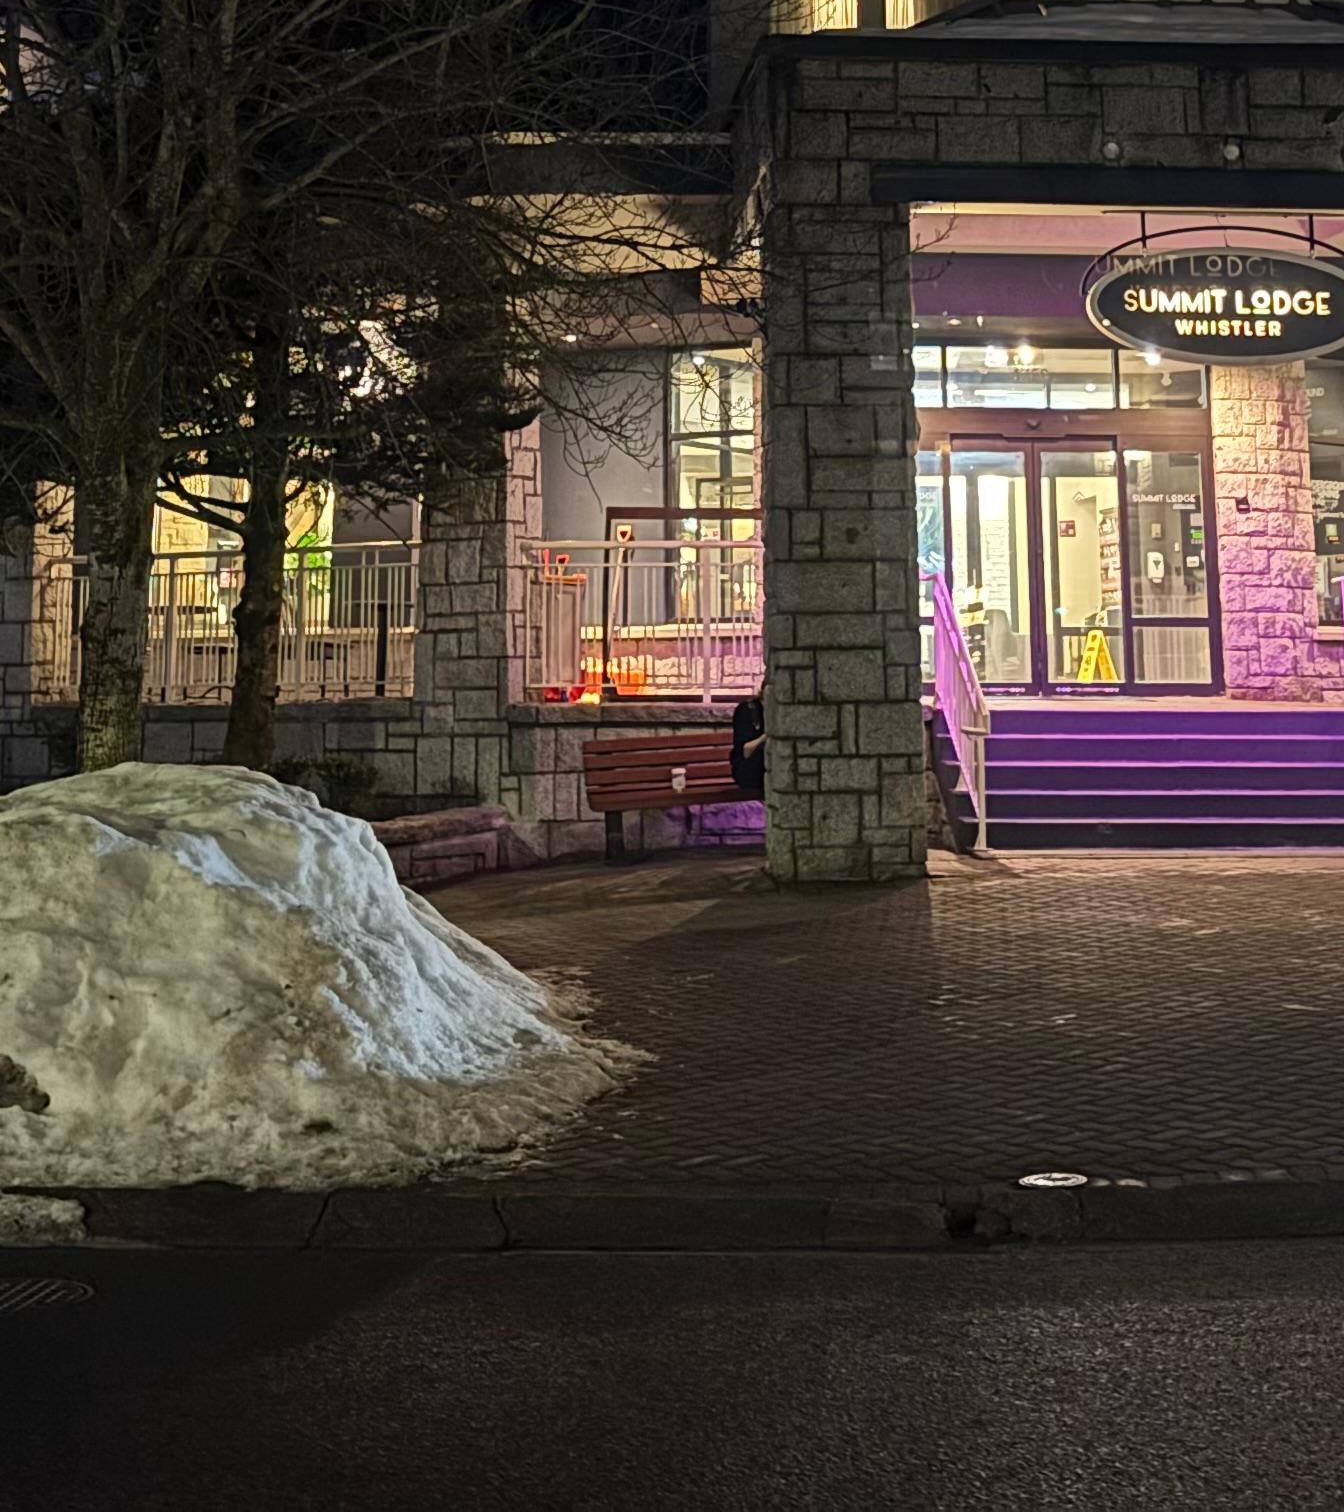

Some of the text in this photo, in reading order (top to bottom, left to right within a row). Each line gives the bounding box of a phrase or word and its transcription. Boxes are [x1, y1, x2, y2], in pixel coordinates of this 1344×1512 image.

[1124, 289, 1331, 315] SUMMIT LODGE
[1175, 318, 1281, 337] WHISTLER
[1132, 494, 1196, 502] SUMMIT LODGE
